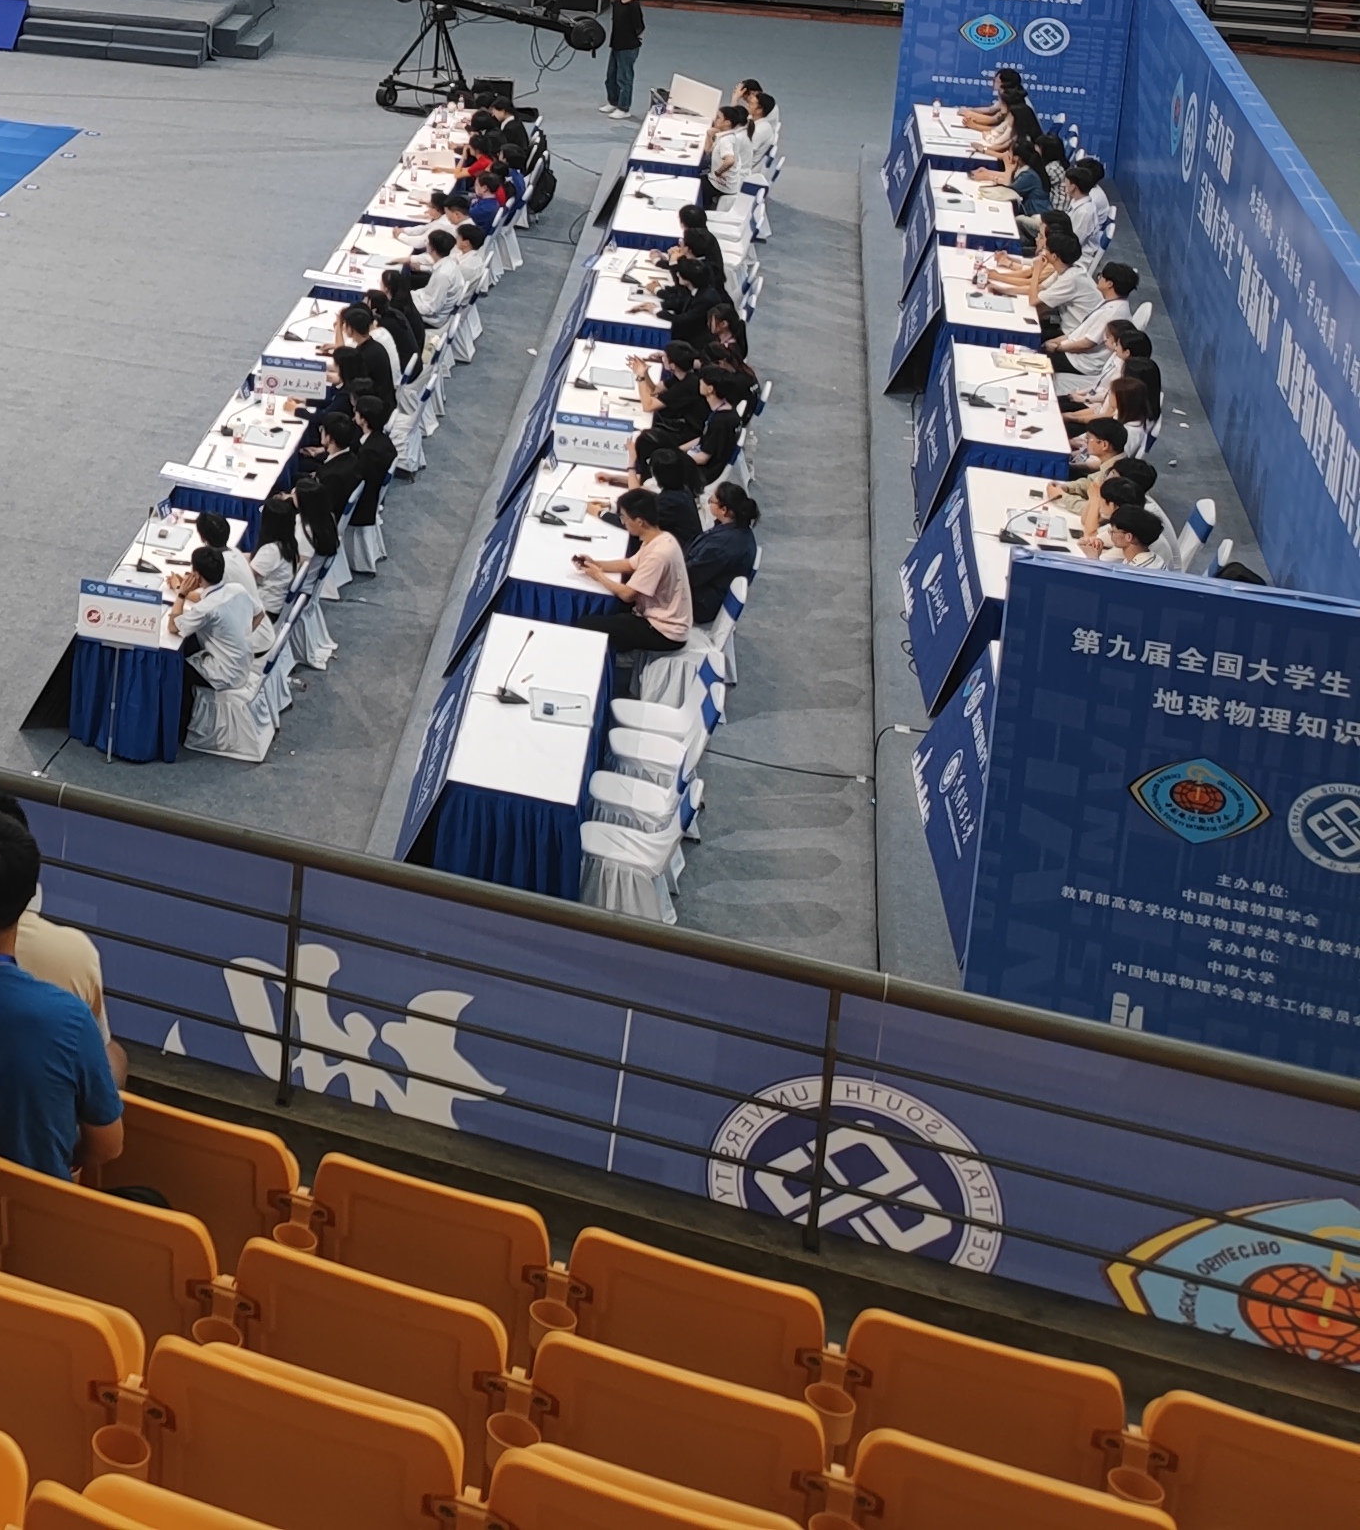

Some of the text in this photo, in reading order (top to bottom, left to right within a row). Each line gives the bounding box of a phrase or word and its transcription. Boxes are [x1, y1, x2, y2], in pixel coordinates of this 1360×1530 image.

[1205, 100, 1235, 185] 第九届
[1196, 171, 1360, 558] 全国大学生“创新杯”地球物理知识
[1070, 627, 1352, 699] 第九届全国大学生
[1291, 794, 1315, 834] CENTRAL
[1181, 888, 1320, 928] 中国地球物理学会
[1207, 961, 1275, 985] 中南大学
